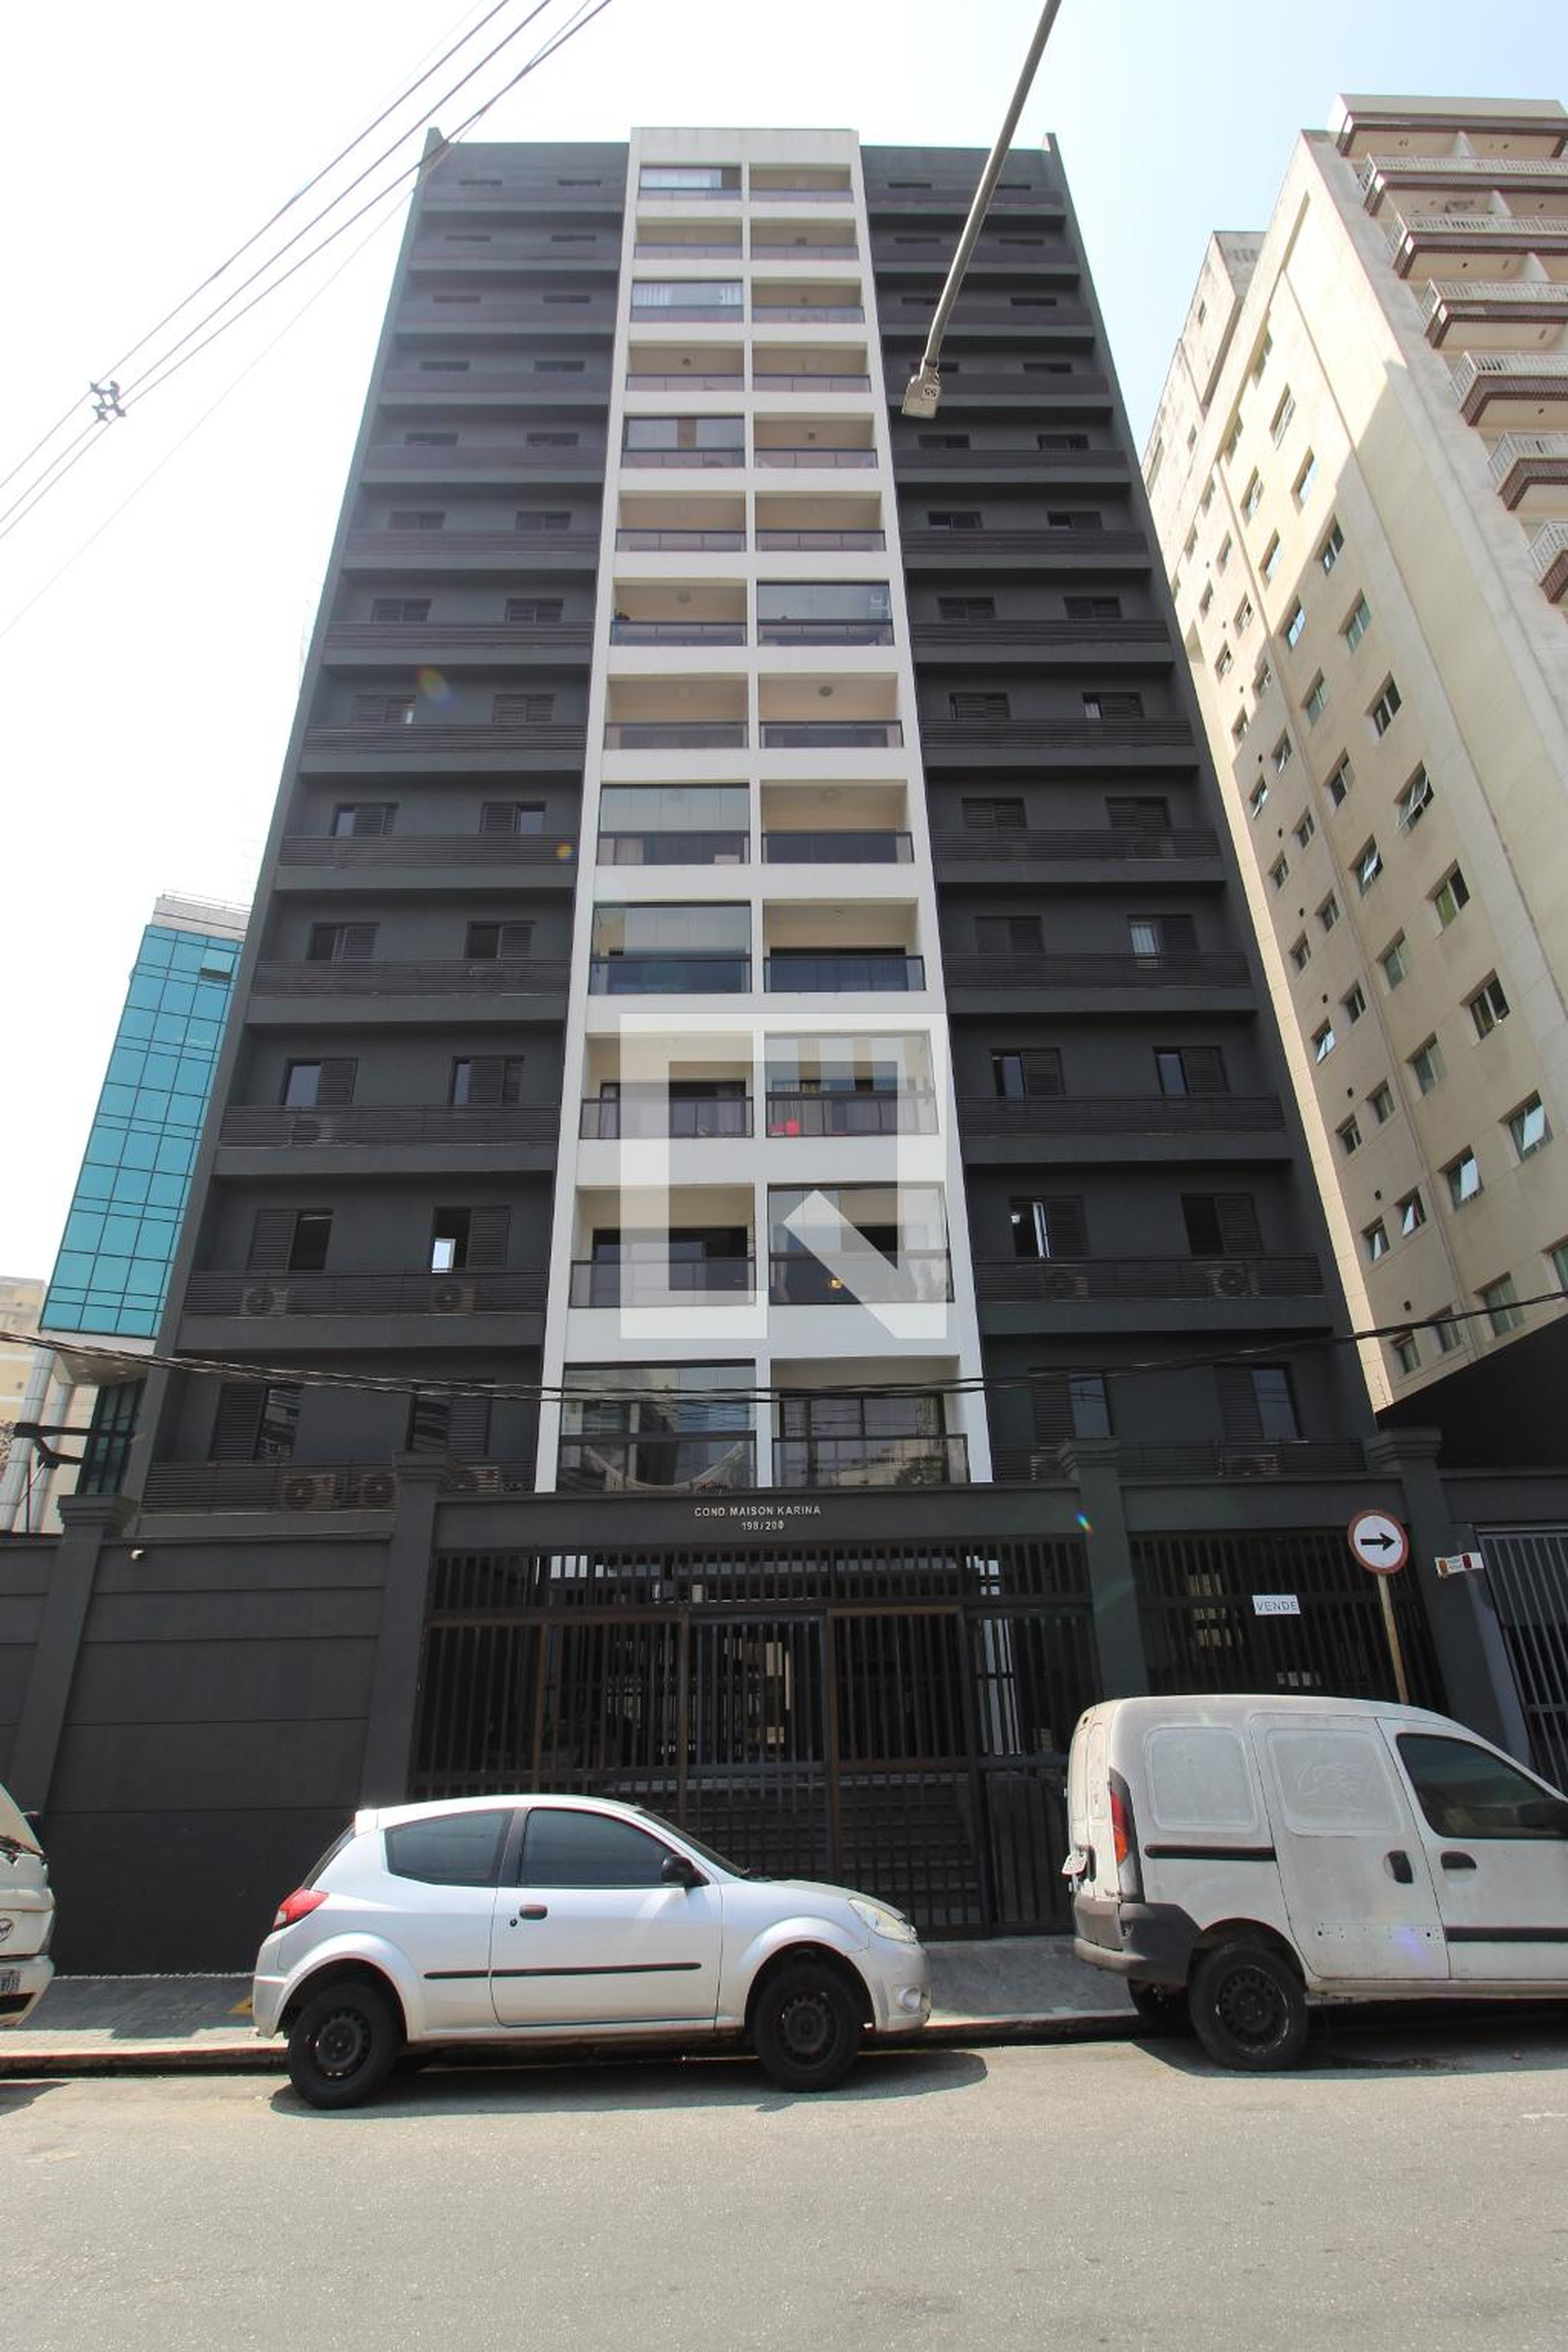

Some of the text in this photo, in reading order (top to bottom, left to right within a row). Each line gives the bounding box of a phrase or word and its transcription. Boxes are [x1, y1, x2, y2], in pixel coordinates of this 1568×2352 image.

[730, 1506, 774, 1516] MAISON
[777, 1506, 821, 1515] KARINA
[1256, 1601, 1298, 1611] VENDE
